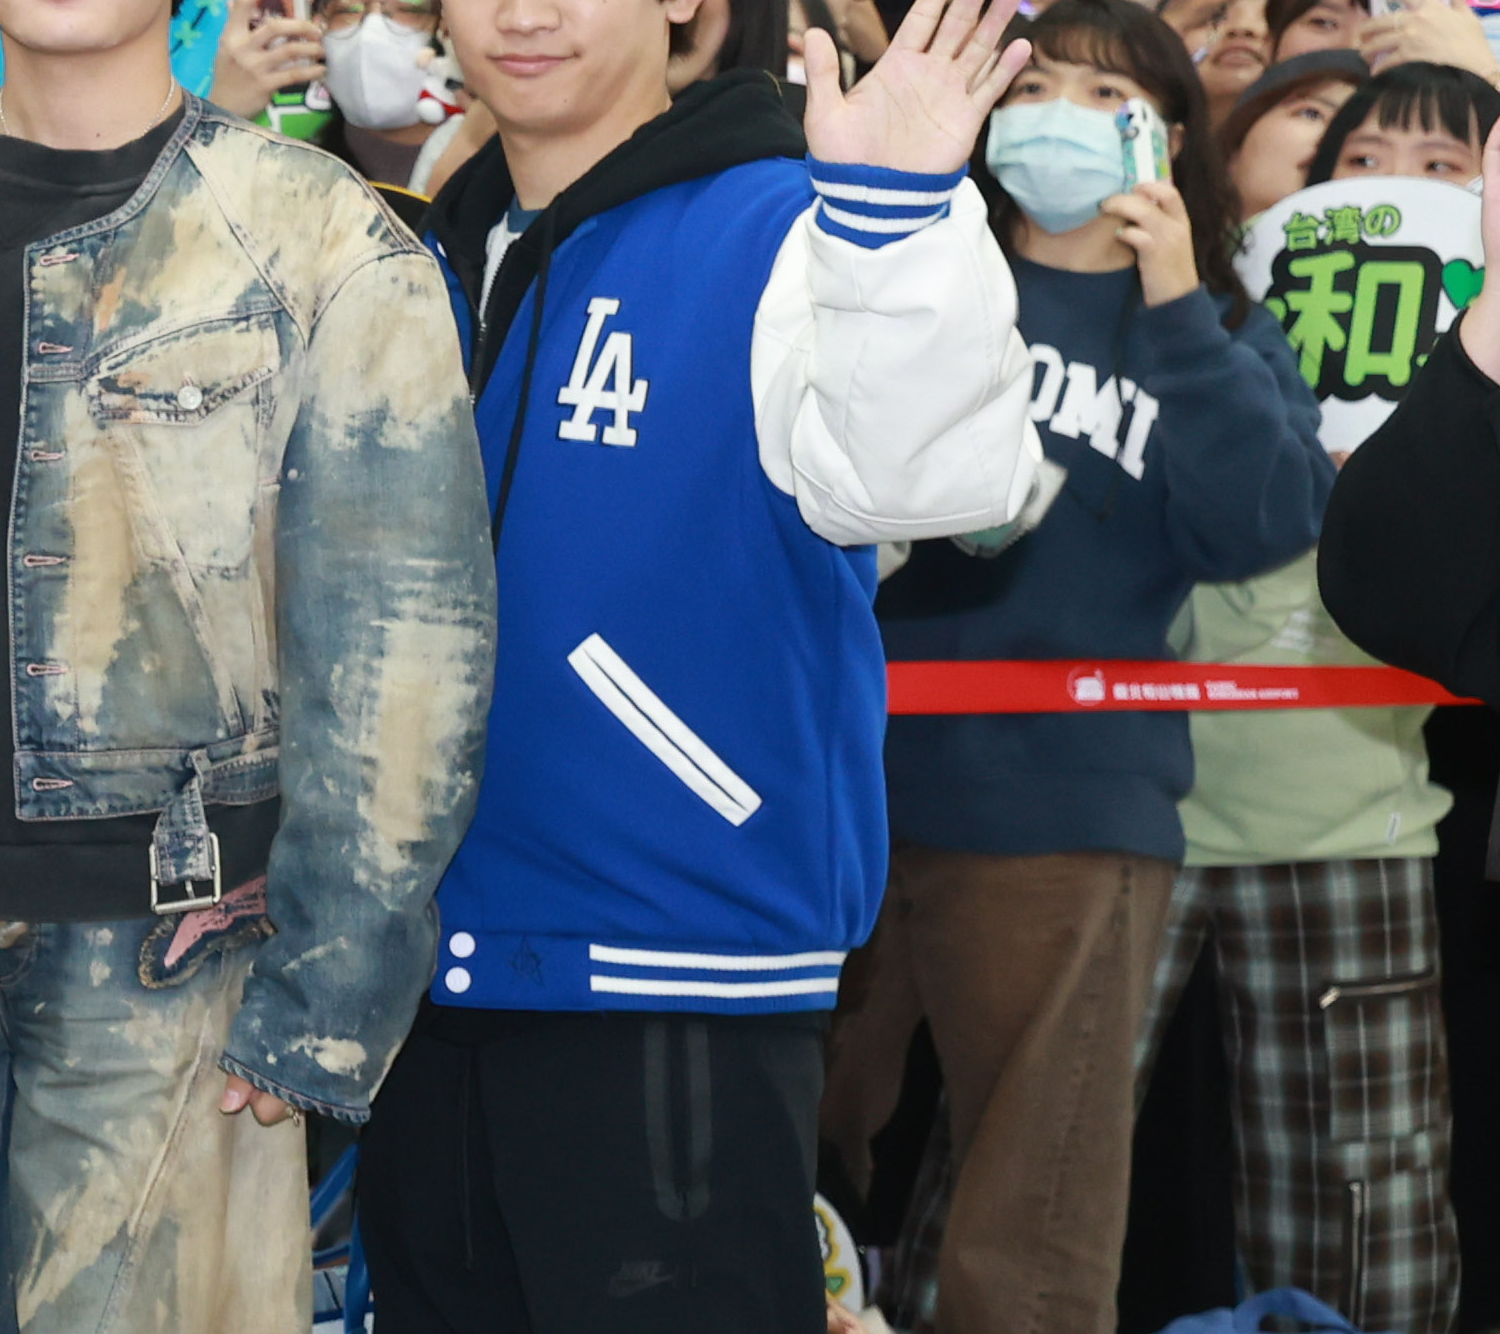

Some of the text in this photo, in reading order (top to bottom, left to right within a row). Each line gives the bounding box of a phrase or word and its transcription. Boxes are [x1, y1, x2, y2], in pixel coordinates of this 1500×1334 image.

[1283, 204, 1402, 251] 台湾の
[557, 296, 649, 447] LA
[1284, 249, 1426, 387] 和
